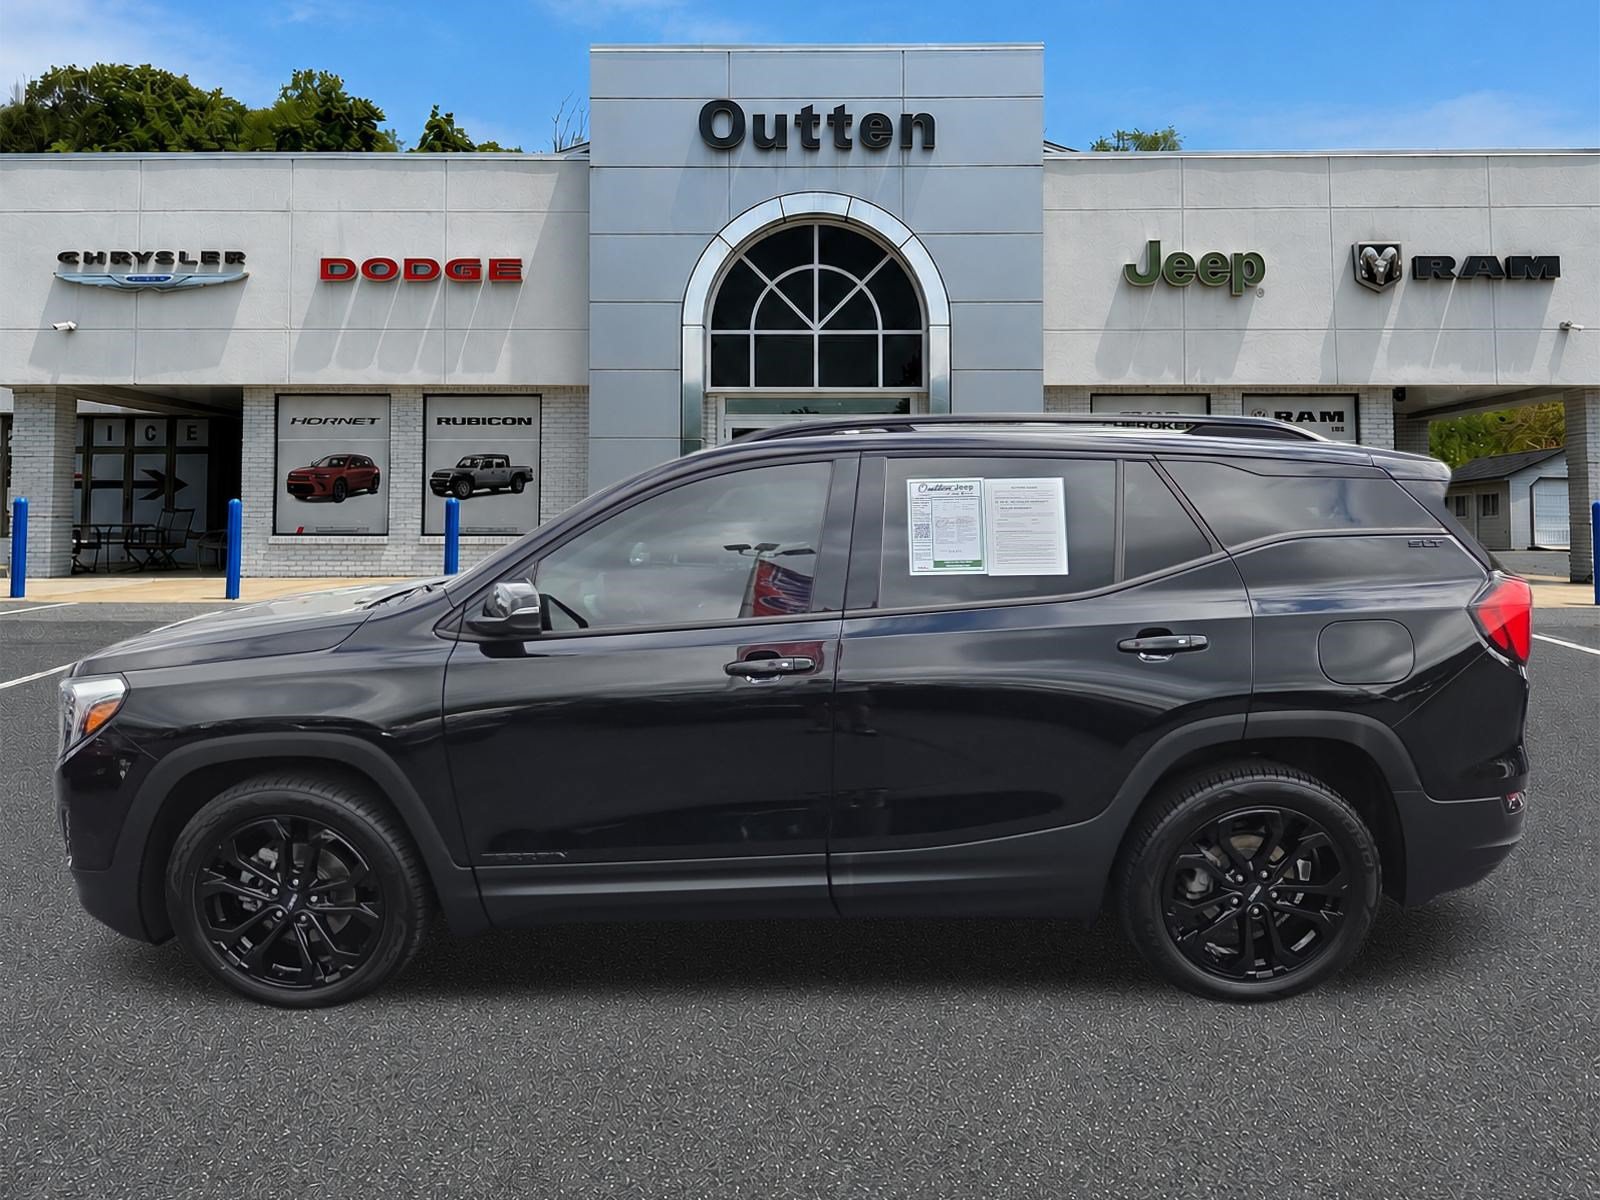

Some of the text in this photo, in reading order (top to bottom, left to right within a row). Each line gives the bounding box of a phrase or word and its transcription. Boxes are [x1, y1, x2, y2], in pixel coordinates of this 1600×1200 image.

[699, 99, 936, 150] Outten
[56, 250, 247, 266] CHRYSLER
[1123, 239, 1266, 297] Jeep
[1411, 255, 1561, 281] RAM
[319, 257, 523, 282] DODGE
[289, 416, 382, 426] HORNET
[435, 416, 533, 426] RUBICON
[1273, 410, 1345, 423] RAM
